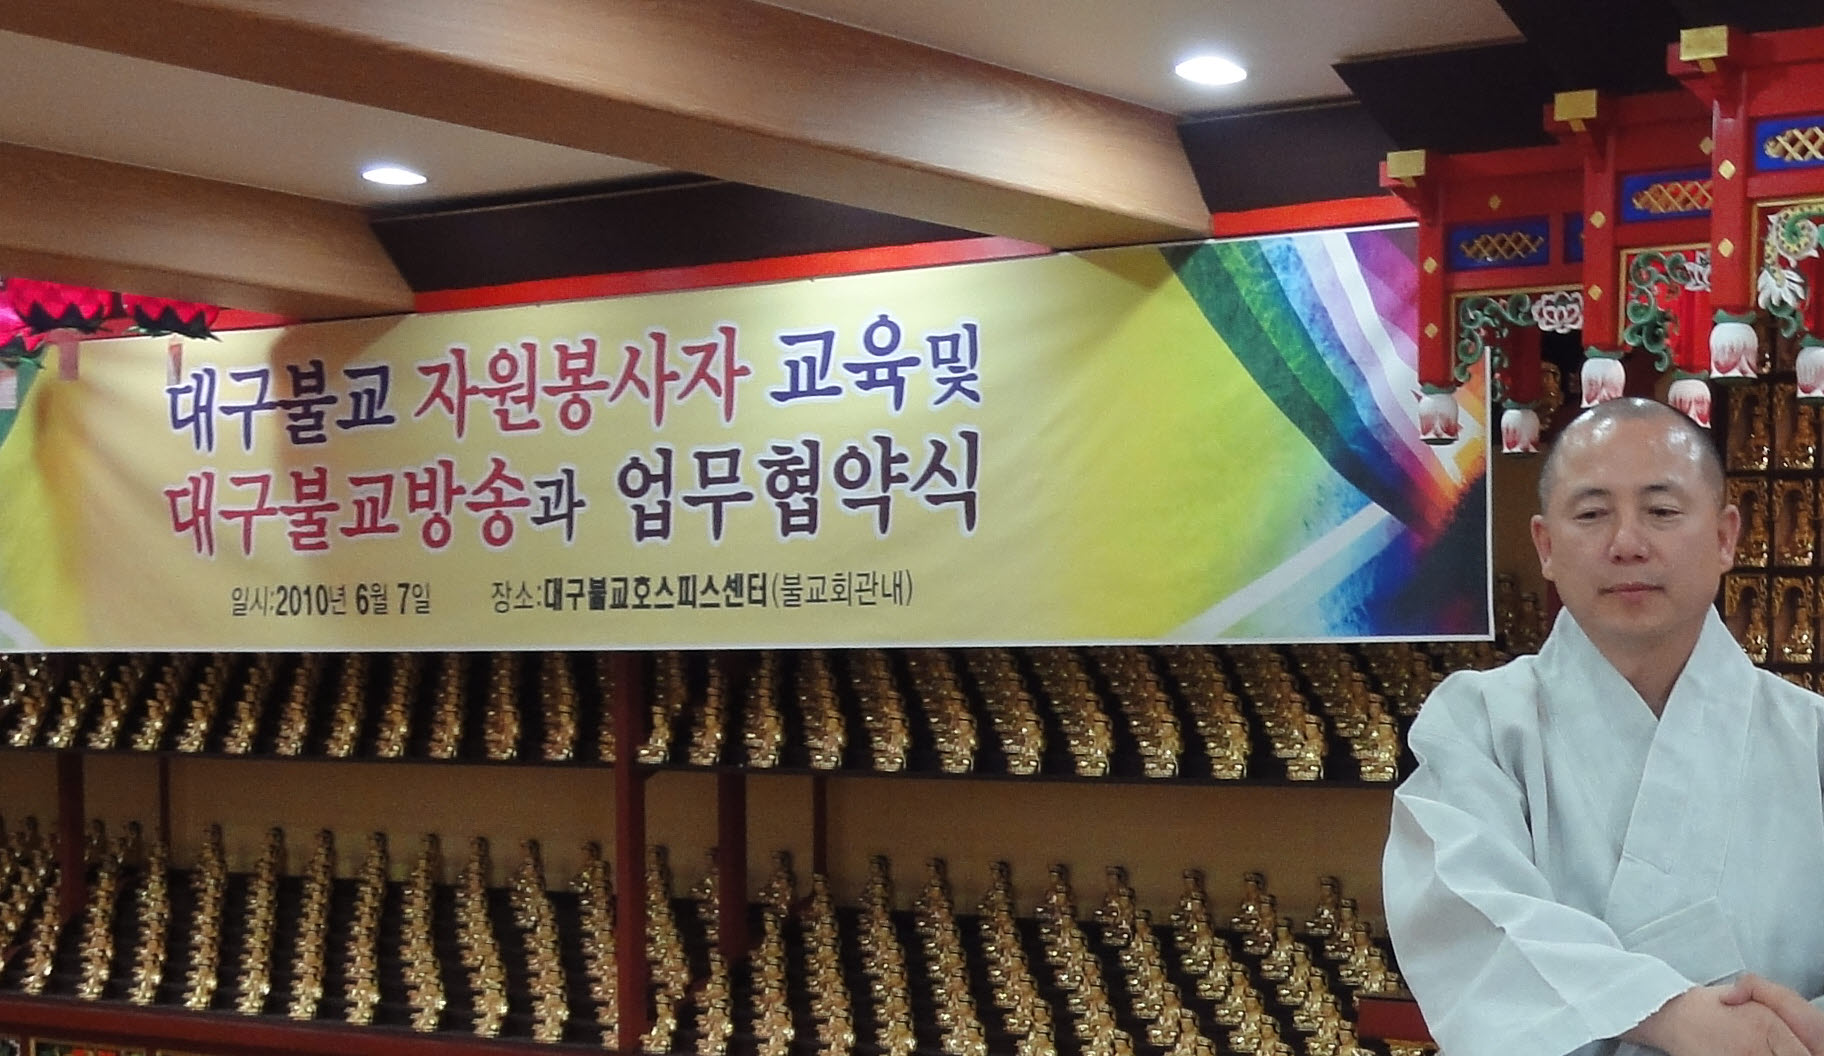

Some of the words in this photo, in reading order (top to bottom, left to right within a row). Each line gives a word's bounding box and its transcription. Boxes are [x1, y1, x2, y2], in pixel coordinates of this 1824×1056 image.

[166, 358, 396, 452] 대구불교
[413, 326, 751, 439] 자원봉사자
[769, 314, 981, 411] 교육및
[164, 456, 587, 557] 대구불교방송과
[617, 430, 980, 542] 업무협약식
[231, 583, 347, 617] 일시:2010년
[355, 582, 389, 616] 6월
[397, 582, 431, 615] 7일
